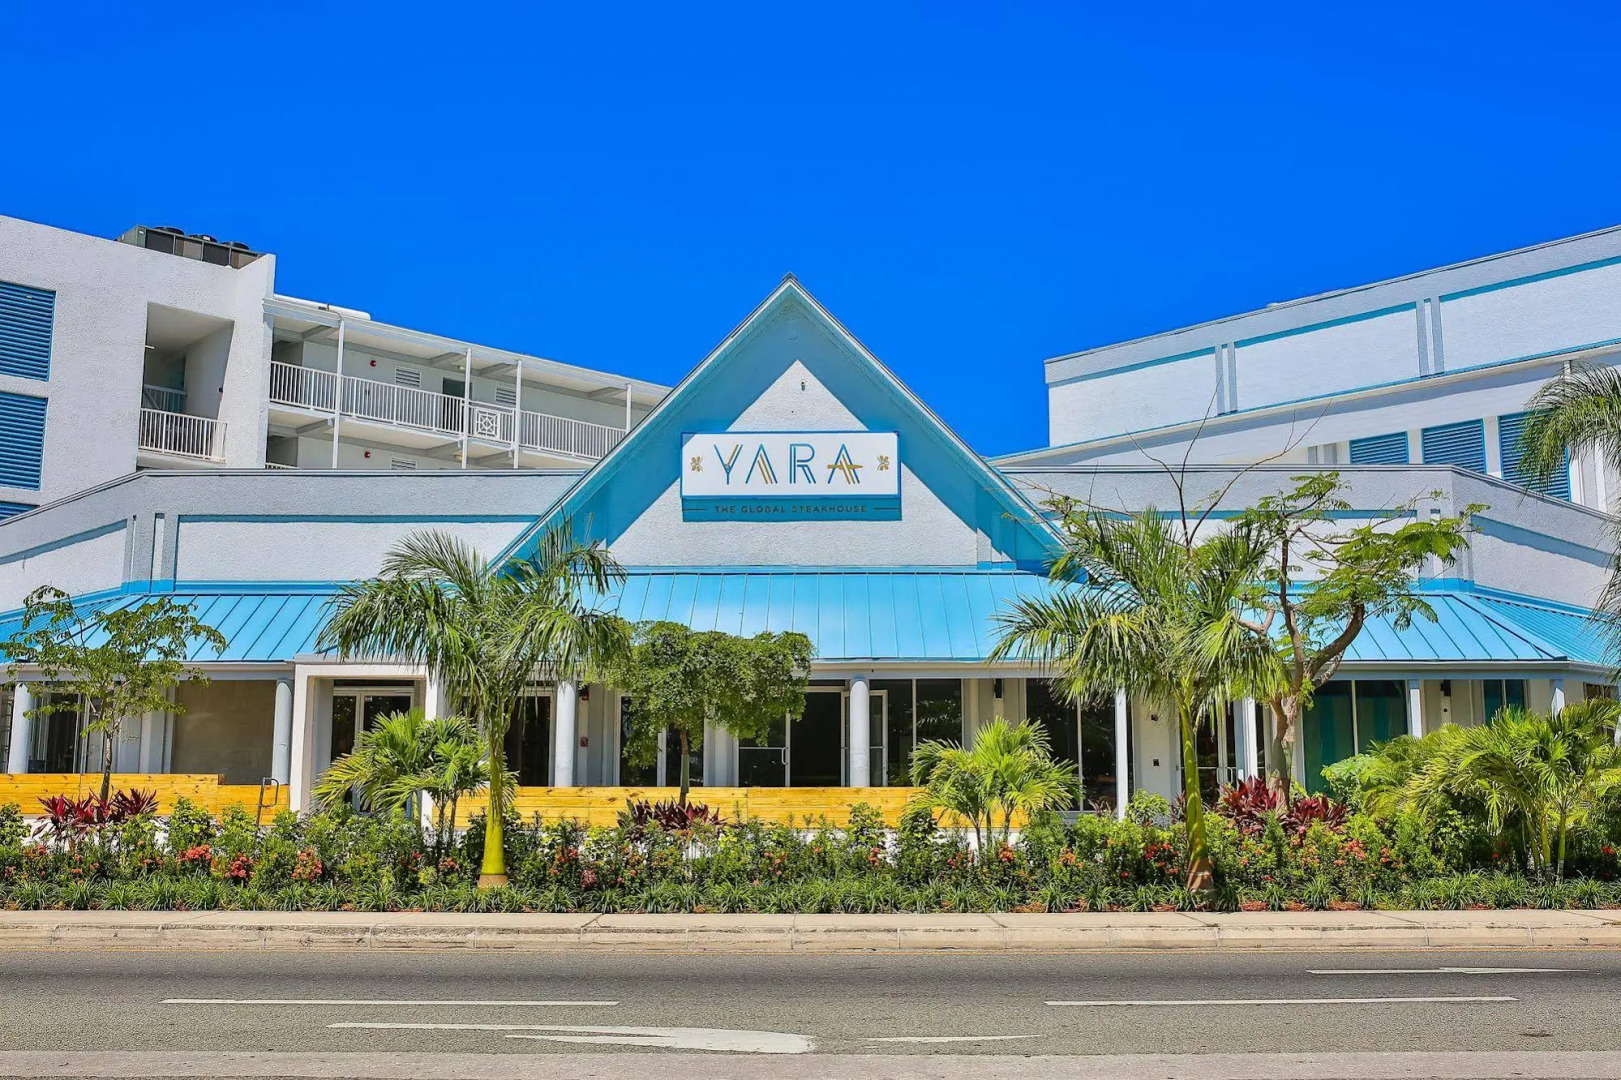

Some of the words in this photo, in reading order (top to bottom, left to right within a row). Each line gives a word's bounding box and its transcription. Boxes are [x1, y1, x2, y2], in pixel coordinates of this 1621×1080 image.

[713, 443, 863, 485] YARA
[715, 505, 736, 513] THE
[741, 505, 785, 513] GLOBAL
[791, 505, 867, 513] STEAKHOUSE
